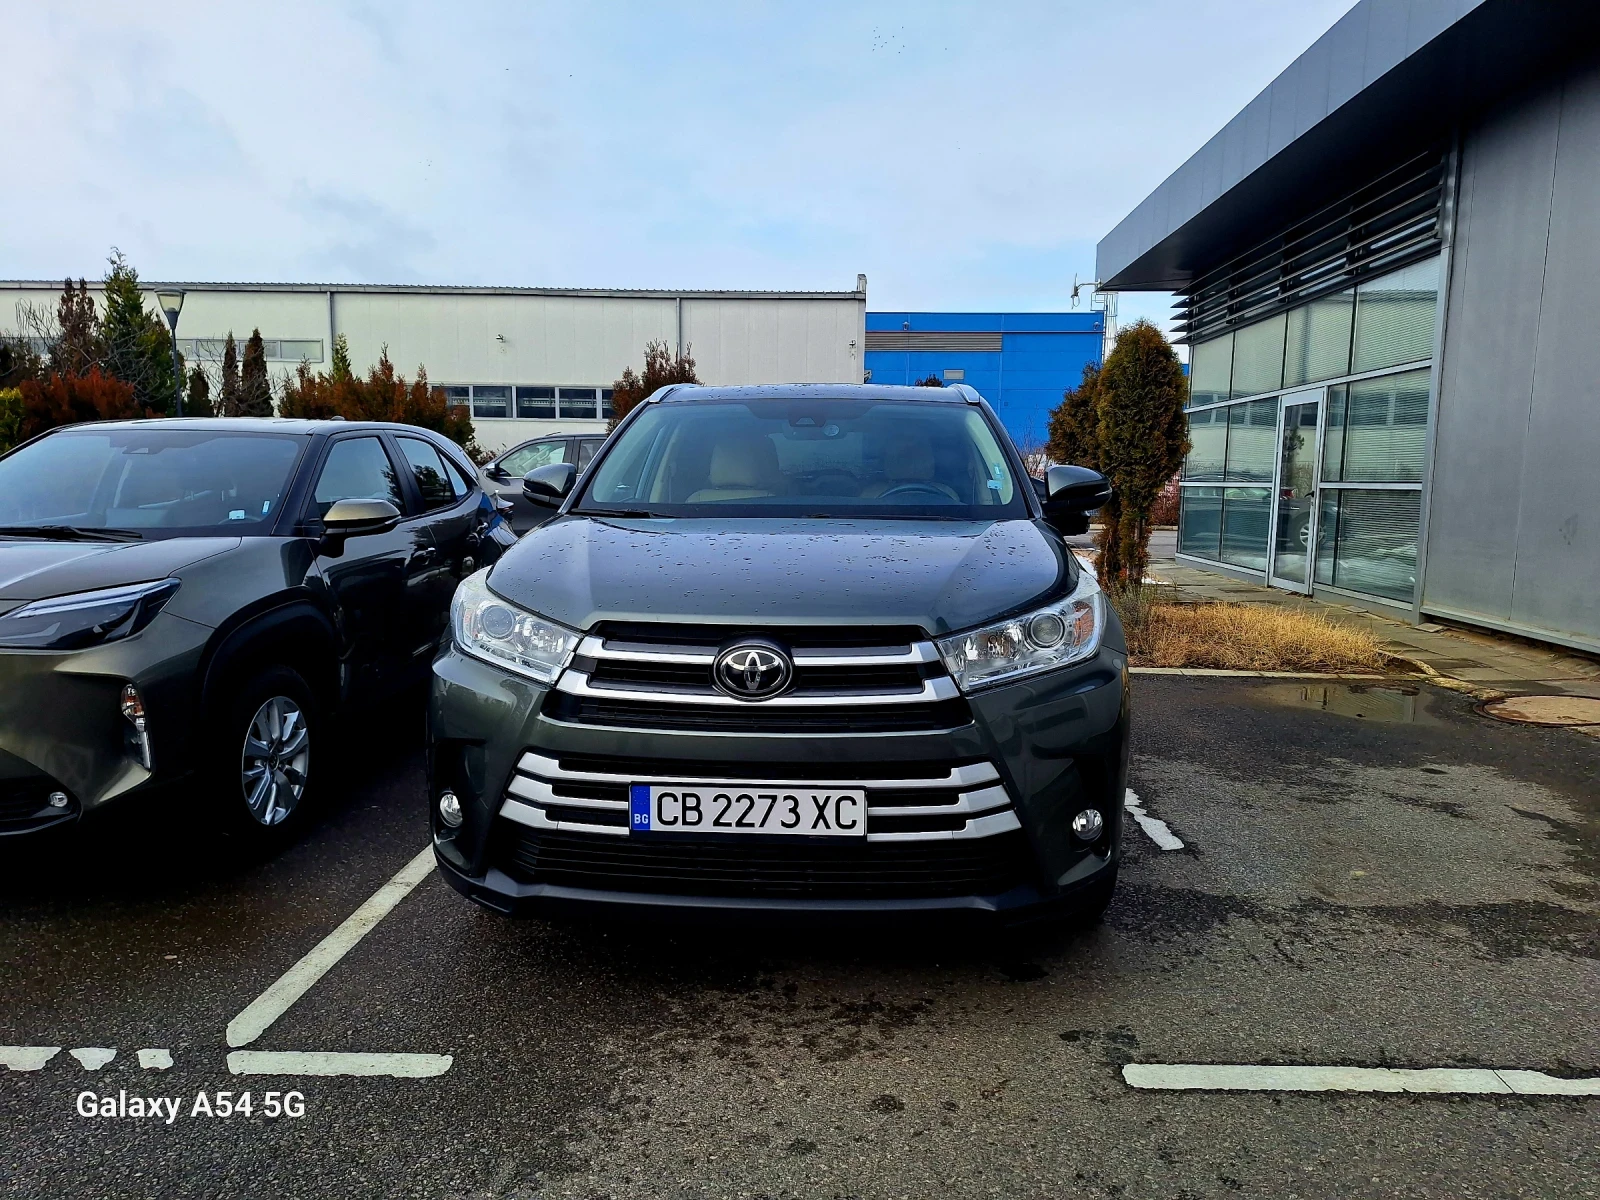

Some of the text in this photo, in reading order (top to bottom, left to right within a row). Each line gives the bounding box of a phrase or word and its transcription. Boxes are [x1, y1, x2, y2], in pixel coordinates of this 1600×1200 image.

[634, 813, 649, 824] BG
[656, 792, 858, 830] CB 2273 XC
